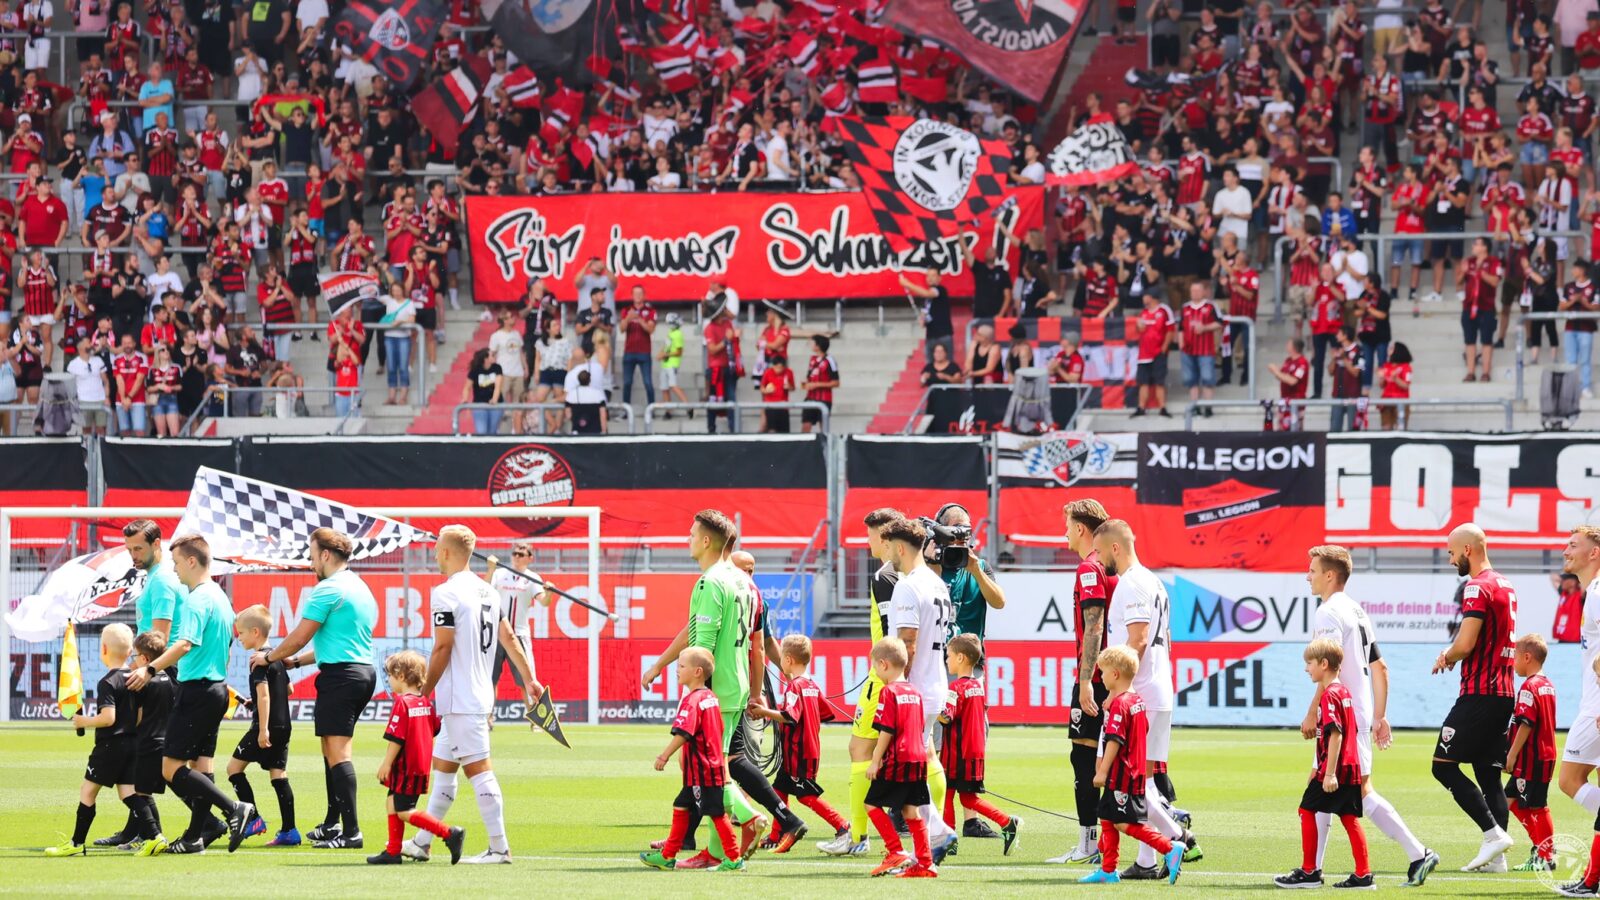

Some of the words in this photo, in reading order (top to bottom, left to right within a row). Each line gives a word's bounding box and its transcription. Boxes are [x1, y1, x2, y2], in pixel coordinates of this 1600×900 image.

[486, 208, 585, 280] Für
[1147, 442, 1315, 471] XII.LEGION
[1218, 501, 1260, 519] LEGION
[435, 613, 445, 625] C
[1189, 596, 1320, 634] MOVI
[1397, 602, 1432, 615] deine
[480, 604, 493, 654] 6
